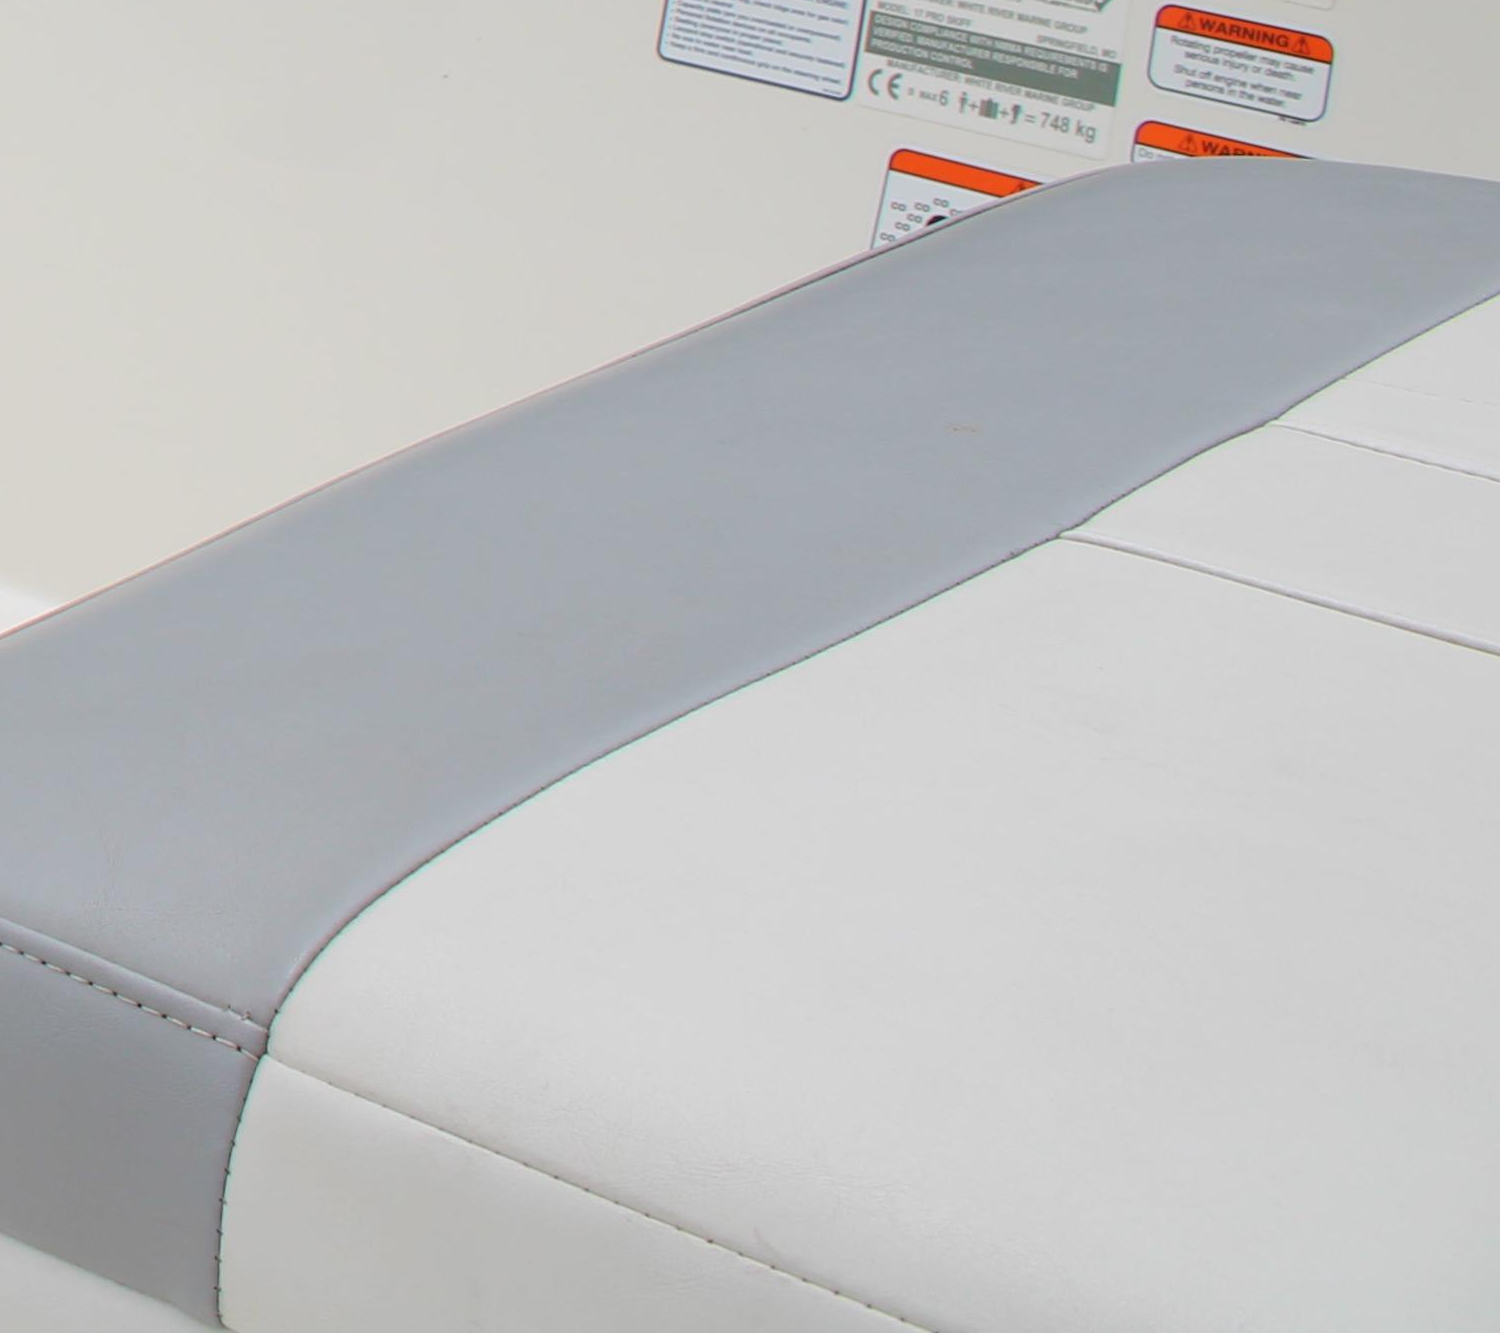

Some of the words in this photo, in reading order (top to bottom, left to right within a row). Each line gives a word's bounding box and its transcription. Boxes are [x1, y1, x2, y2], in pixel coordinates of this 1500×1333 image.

[1197, 16, 1291, 49] WARNING
[865, 65, 903, 100] CE
[937, 88, 950, 106] 6
[1039, 110, 1072, 133] 748
[1073, 119, 1097, 144] kg
